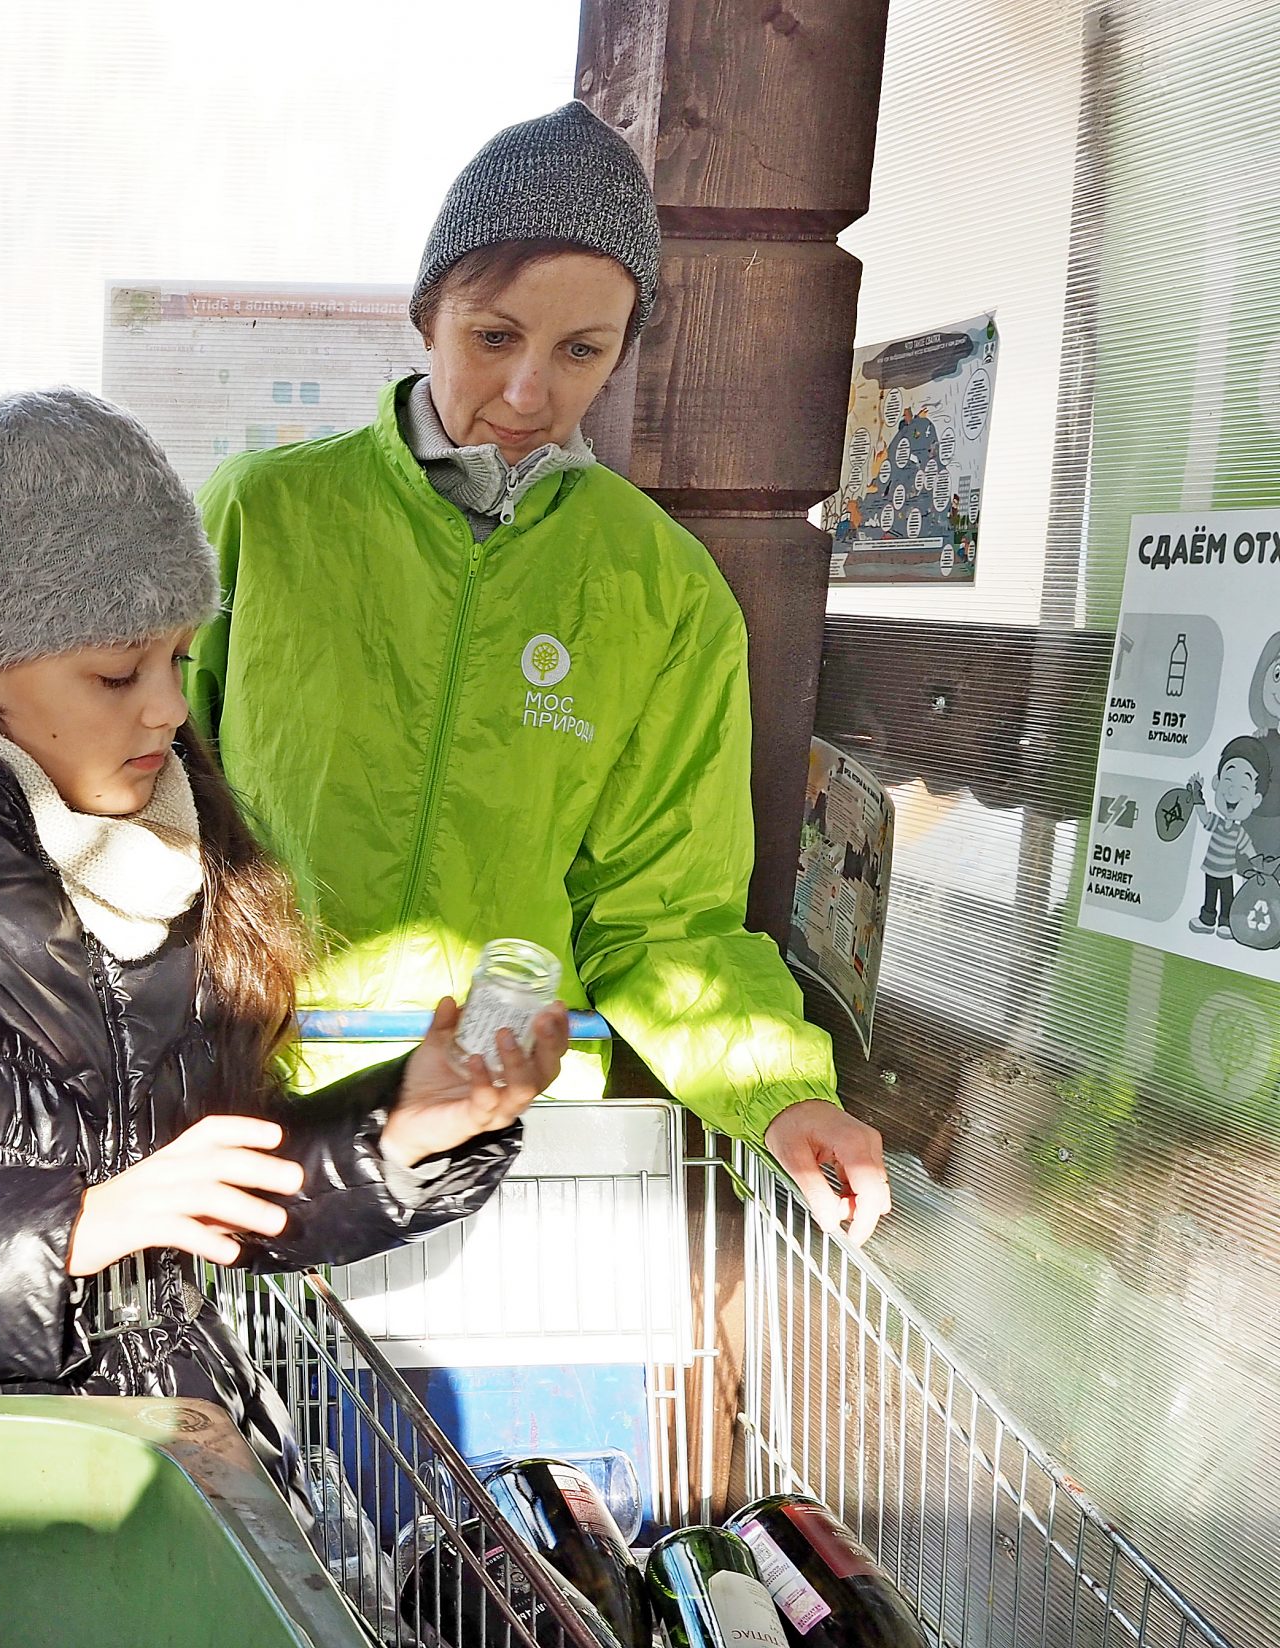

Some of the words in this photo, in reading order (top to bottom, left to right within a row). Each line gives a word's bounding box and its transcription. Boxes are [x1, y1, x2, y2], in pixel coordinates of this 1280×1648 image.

[1138, 525, 1227, 570] СДАЁМ
[525, 690, 574, 714] МОС
[1152, 711, 1161, 726] 5
[1163, 712, 1187, 728] ПЭТ
[1148, 730, 1189, 744] БУТЫЛОК
[1093, 844, 1112, 862] 20
[1094, 884, 1141, 904] БАТАРЕЙКА
[731, 1629, 781, 1646] TUTIAC
